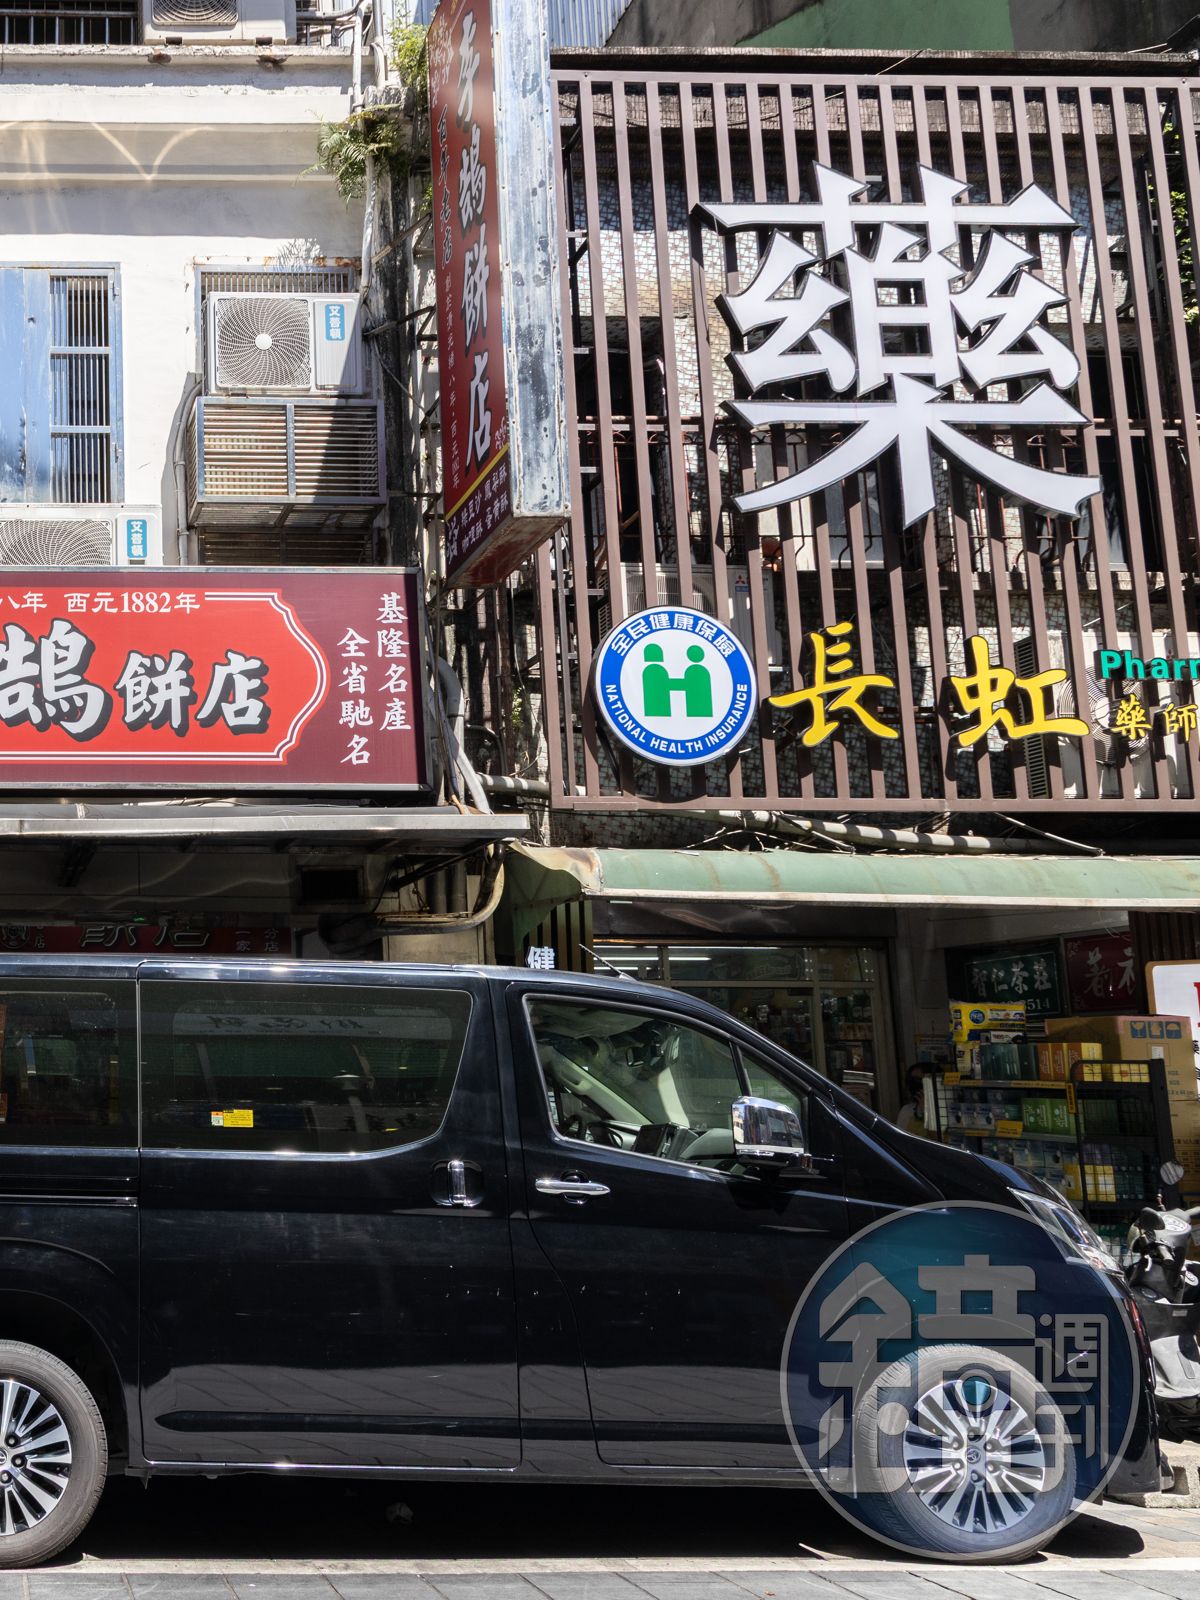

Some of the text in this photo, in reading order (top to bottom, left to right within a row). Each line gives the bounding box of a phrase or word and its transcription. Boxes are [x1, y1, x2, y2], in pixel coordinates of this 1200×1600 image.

[456, 9, 493, 478] 李鵠餅店
[693, 160, 1104, 531] 藥
[130, 520, 144, 557] 艾普頓
[63, 590, 201, 614] 西元1882年
[610, 612, 737, 659] 全民健康保險
[336, 626, 374, 767] 全省馳名
[375, 591, 412, 732] 基隆名產
[767, 621, 1090, 749] 長虹
[605, 683, 748, 755] NATIONAL HEALTH INSURANCE
[1111, 693, 1198, 742] 藥師
